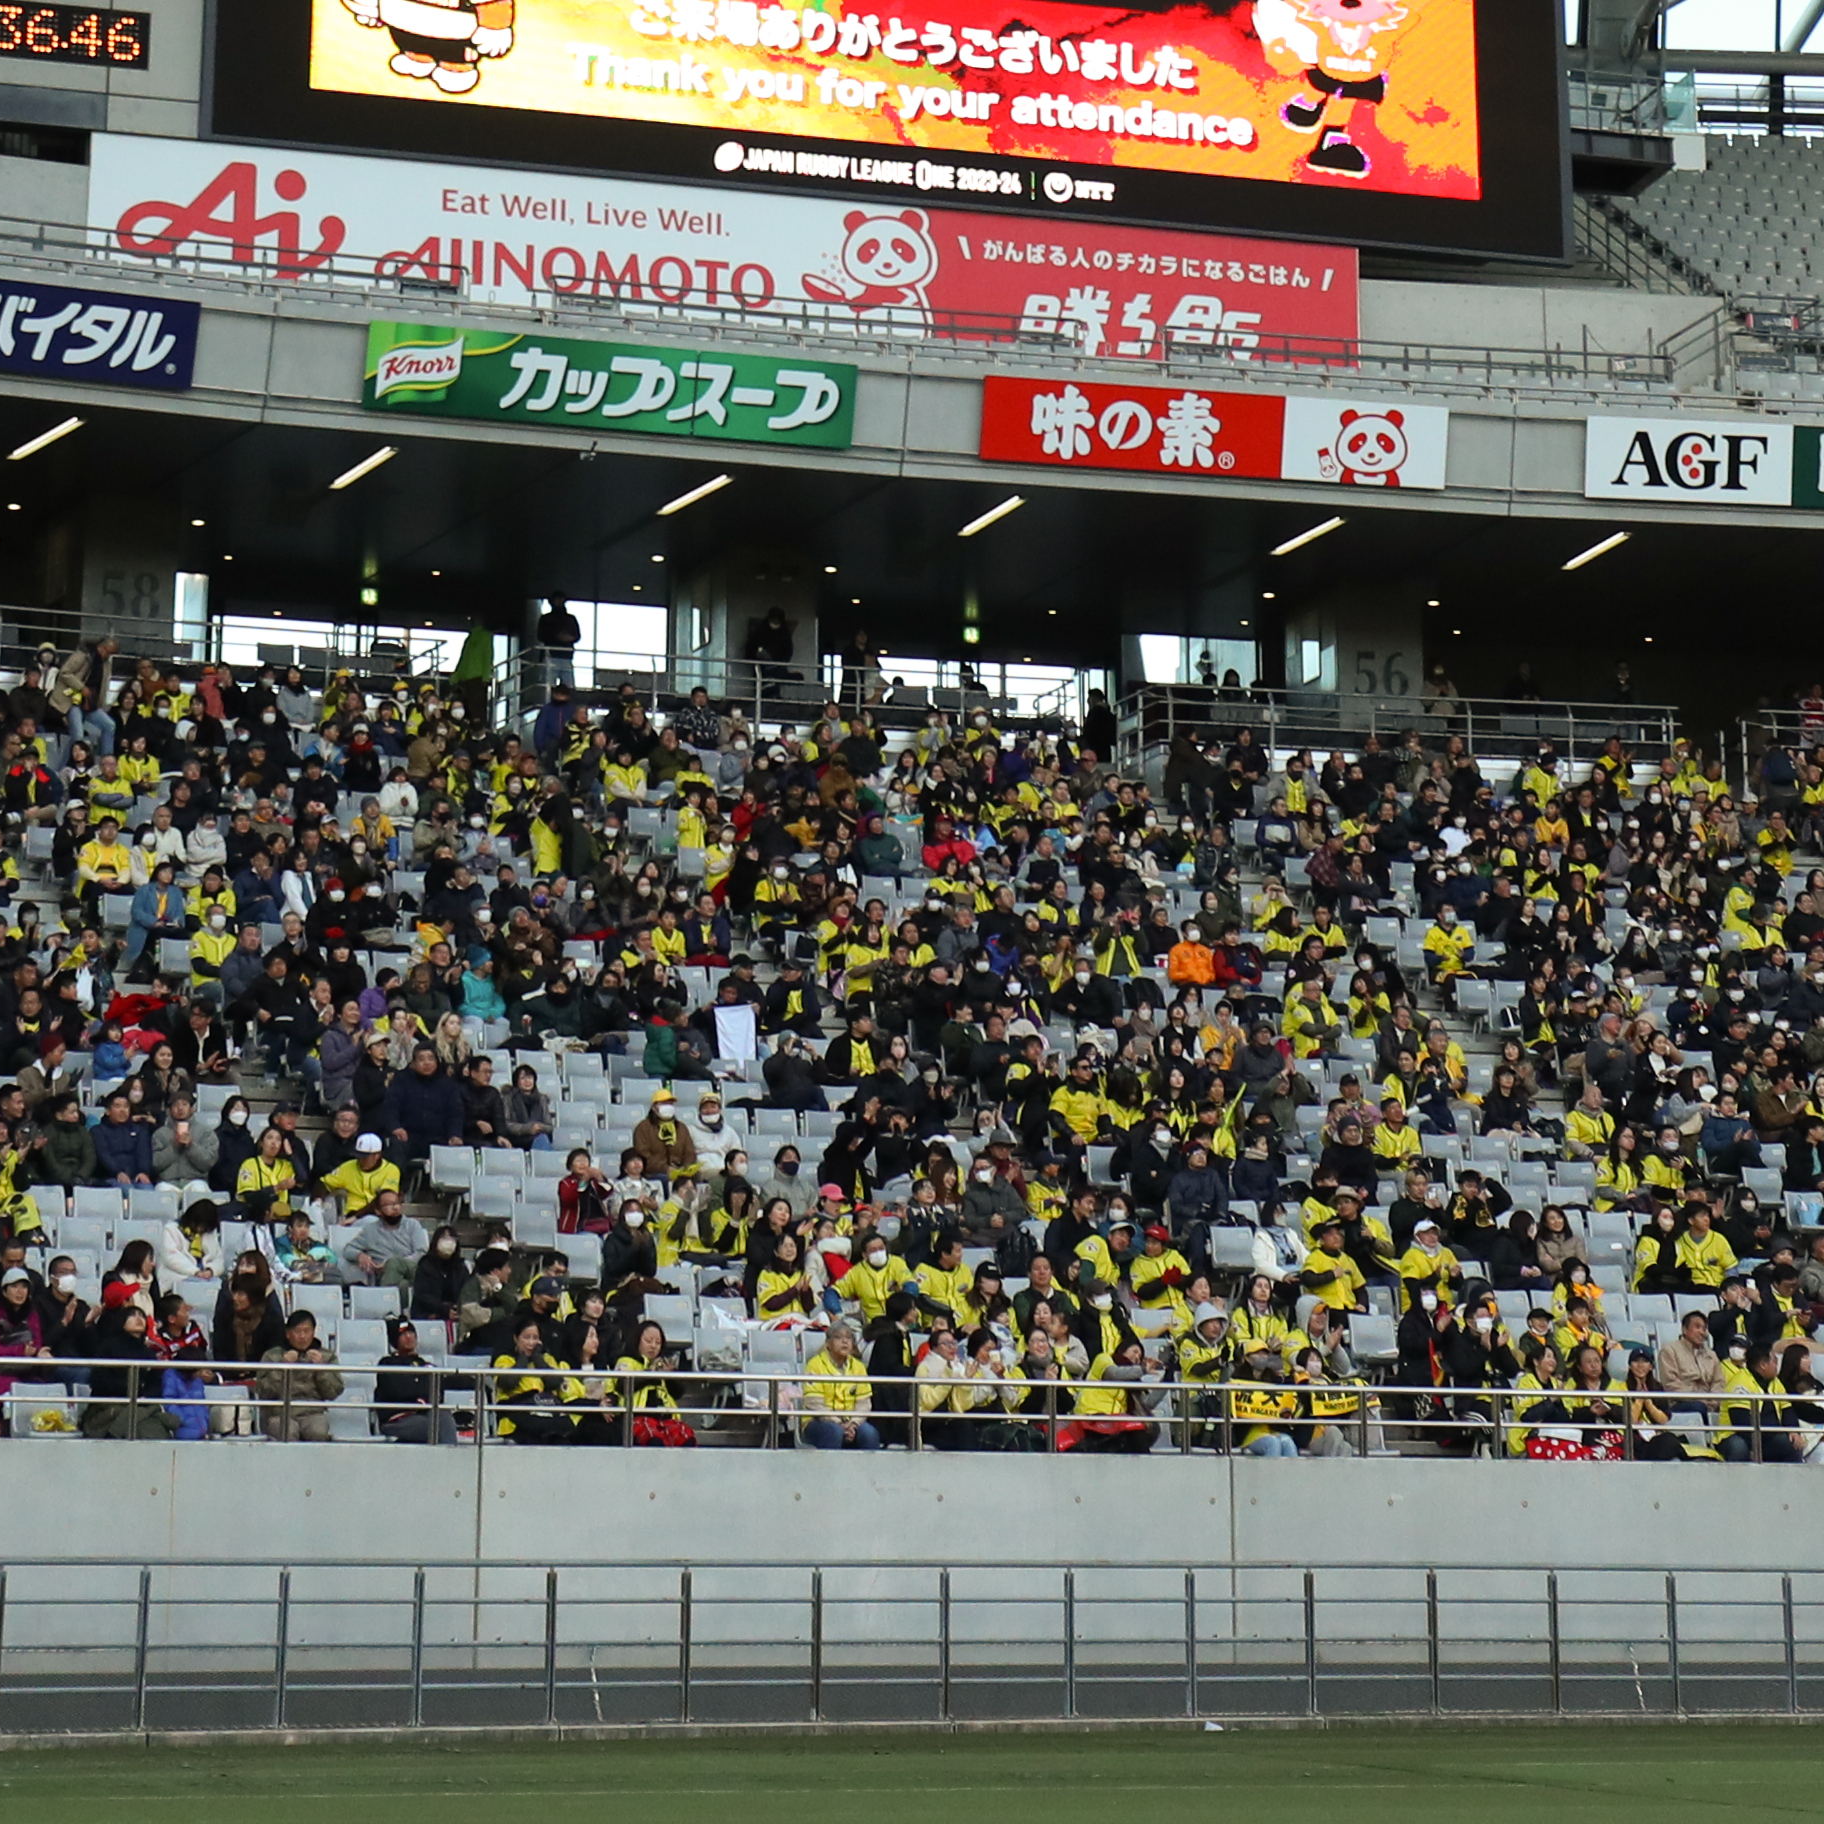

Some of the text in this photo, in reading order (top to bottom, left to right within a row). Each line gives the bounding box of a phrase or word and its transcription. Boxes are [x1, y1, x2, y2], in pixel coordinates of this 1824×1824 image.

[565, 41, 1254, 146] Thank you for your attendance
[742, 147, 795, 173] JAPAN
[796, 152, 850, 179] RUGBY
[850, 156, 914, 186] LEAGUE
[441, 187, 732, 238] Eat Well, Live Well.
[982, 238, 1311, 289] がんばる人のチカラになるごはん
[382, 354, 457, 381] Knorr
[499, 344, 840, 430] カップスープ
[1031, 384, 1221, 468] 味の素
[1611, 431, 1768, 490] AGF
[100, 568, 162, 620] 58
[1354, 651, 1409, 696] 56
